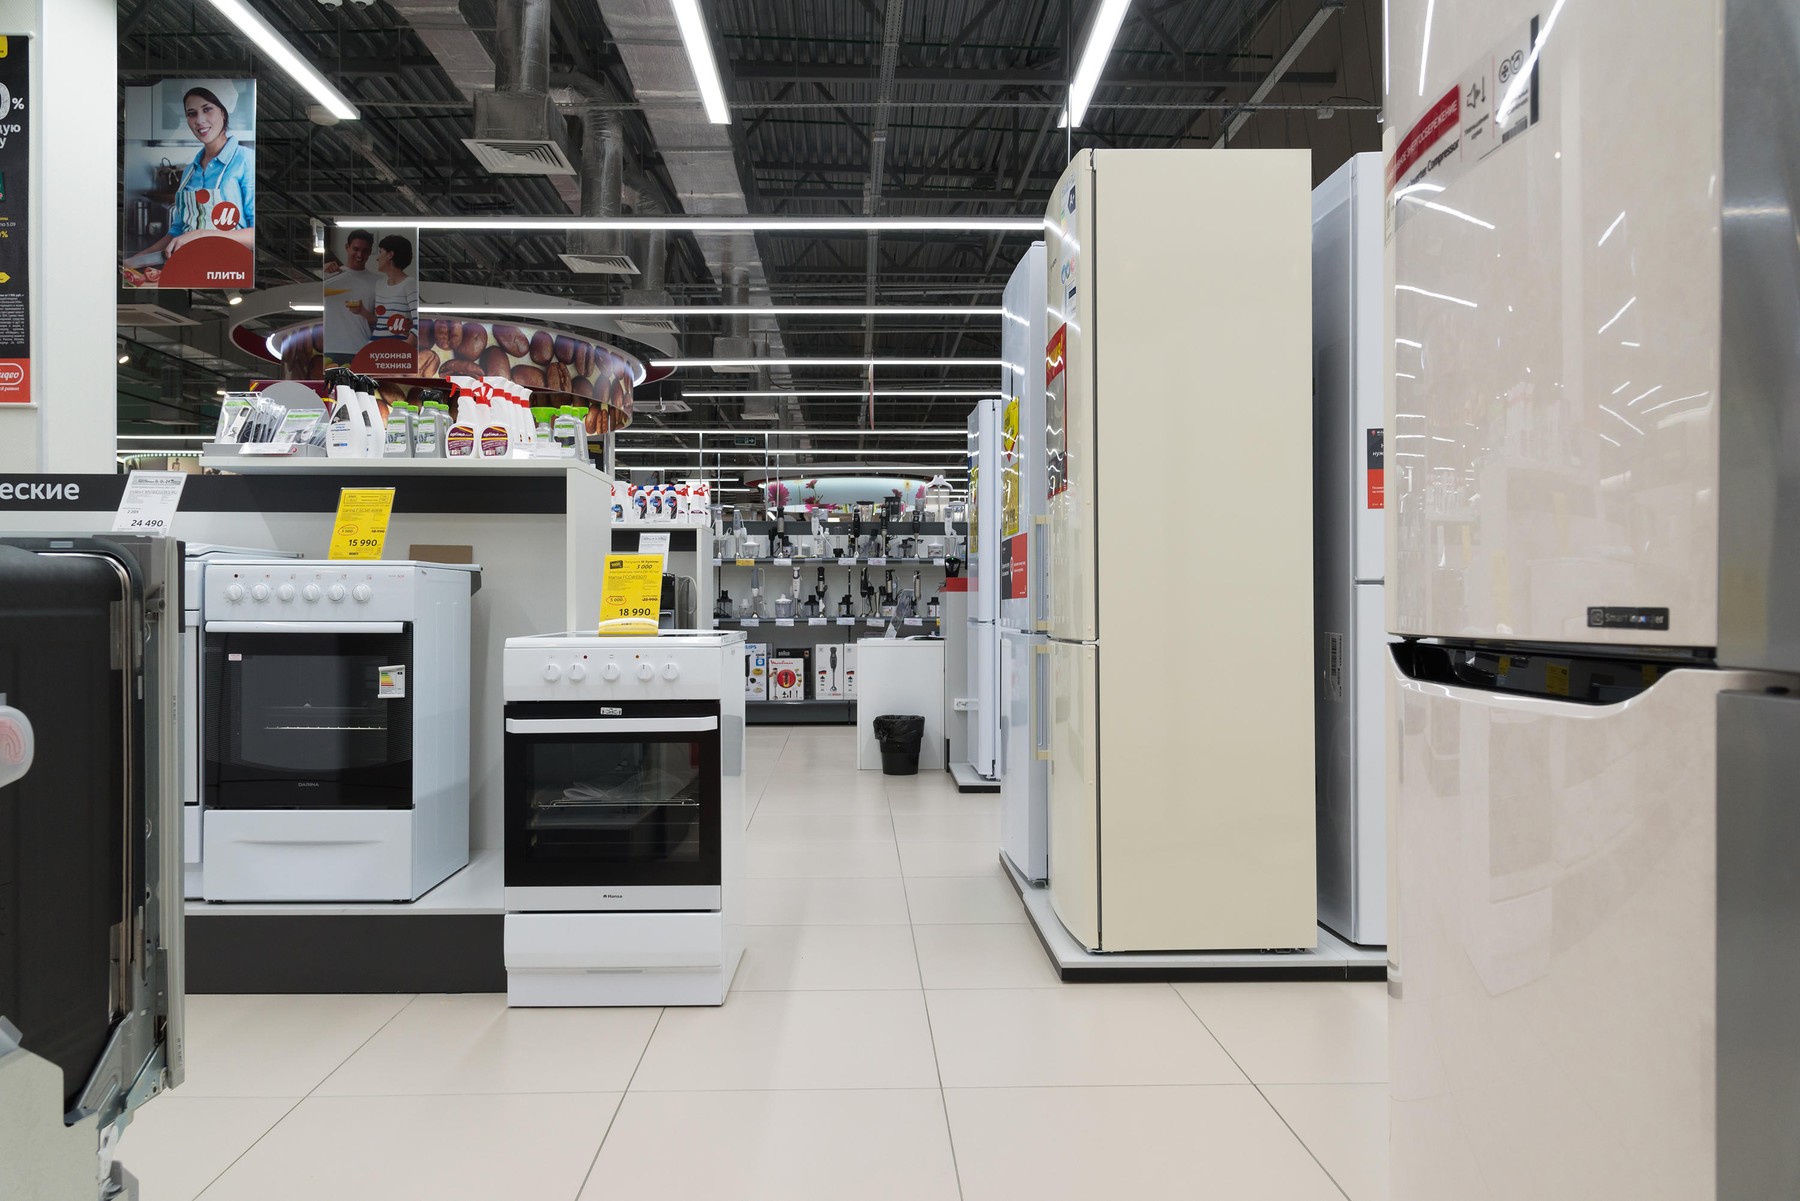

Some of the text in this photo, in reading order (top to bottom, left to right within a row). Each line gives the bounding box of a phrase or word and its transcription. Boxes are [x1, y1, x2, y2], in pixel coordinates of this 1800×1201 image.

[1428, 139, 1460, 171] Compressor
[206, 271, 245, 280] плиты
[370, 352, 412, 361] кухонная
[0, 482, 80, 501] еские
[131, 519, 164, 527] 24 490
[348, 539, 378, 547] 15 990
[619, 608, 651, 616] 18 990
